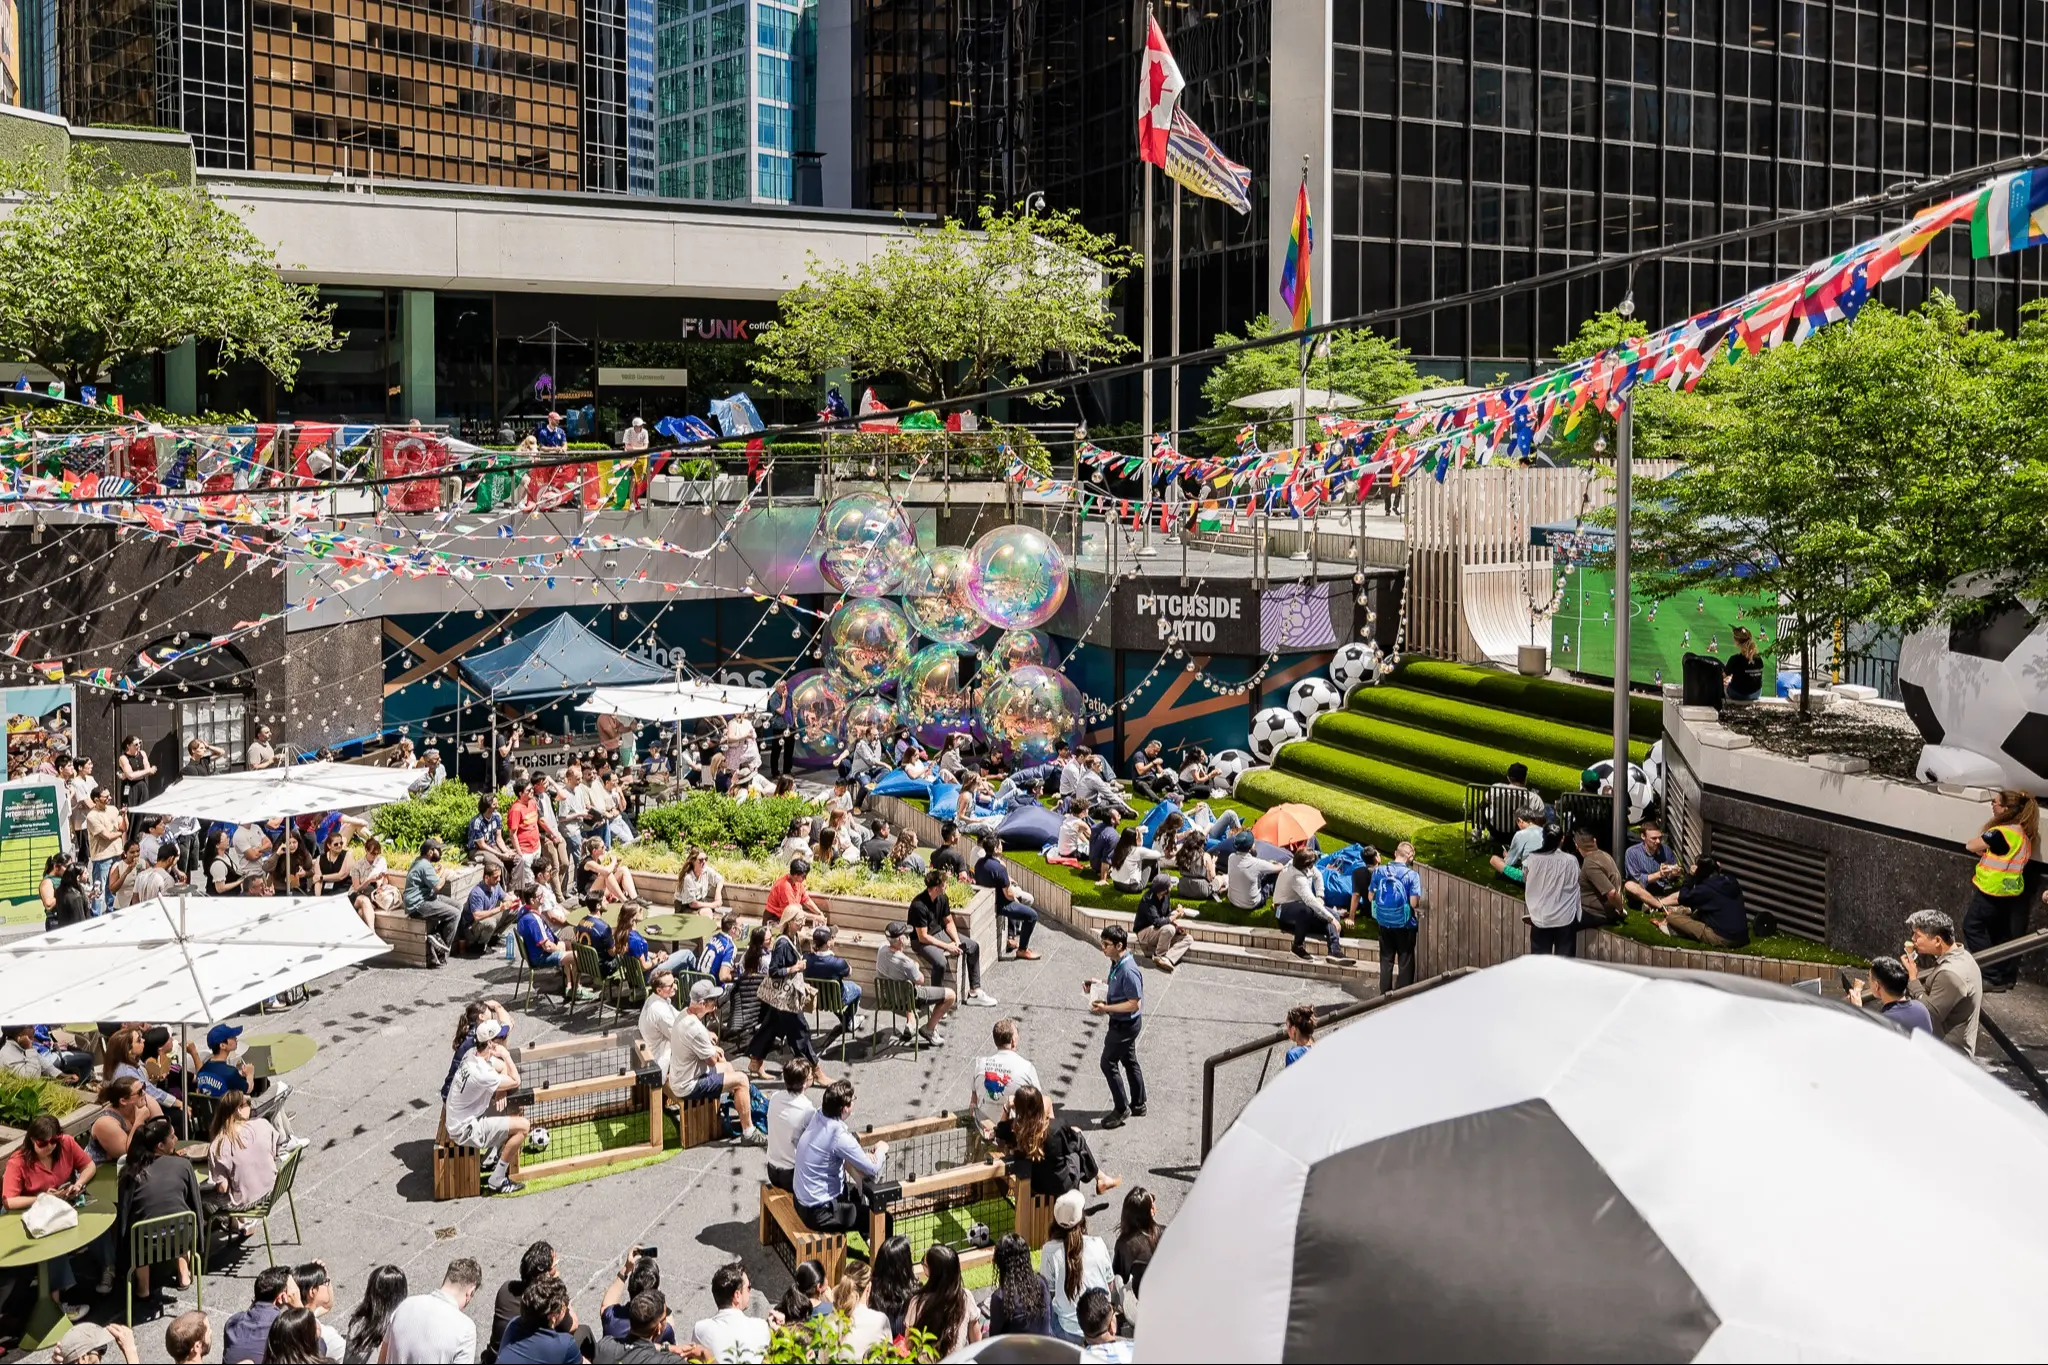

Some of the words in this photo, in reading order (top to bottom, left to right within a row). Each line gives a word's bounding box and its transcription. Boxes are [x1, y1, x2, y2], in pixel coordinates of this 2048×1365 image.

[682, 318, 749, 340] FUNK
[1137, 594, 1241, 619] PITCHSIDE
[1158, 619, 1216, 643] PATIO
[636, 643, 686, 668] the
[1082, 692, 1107, 715] Patio
